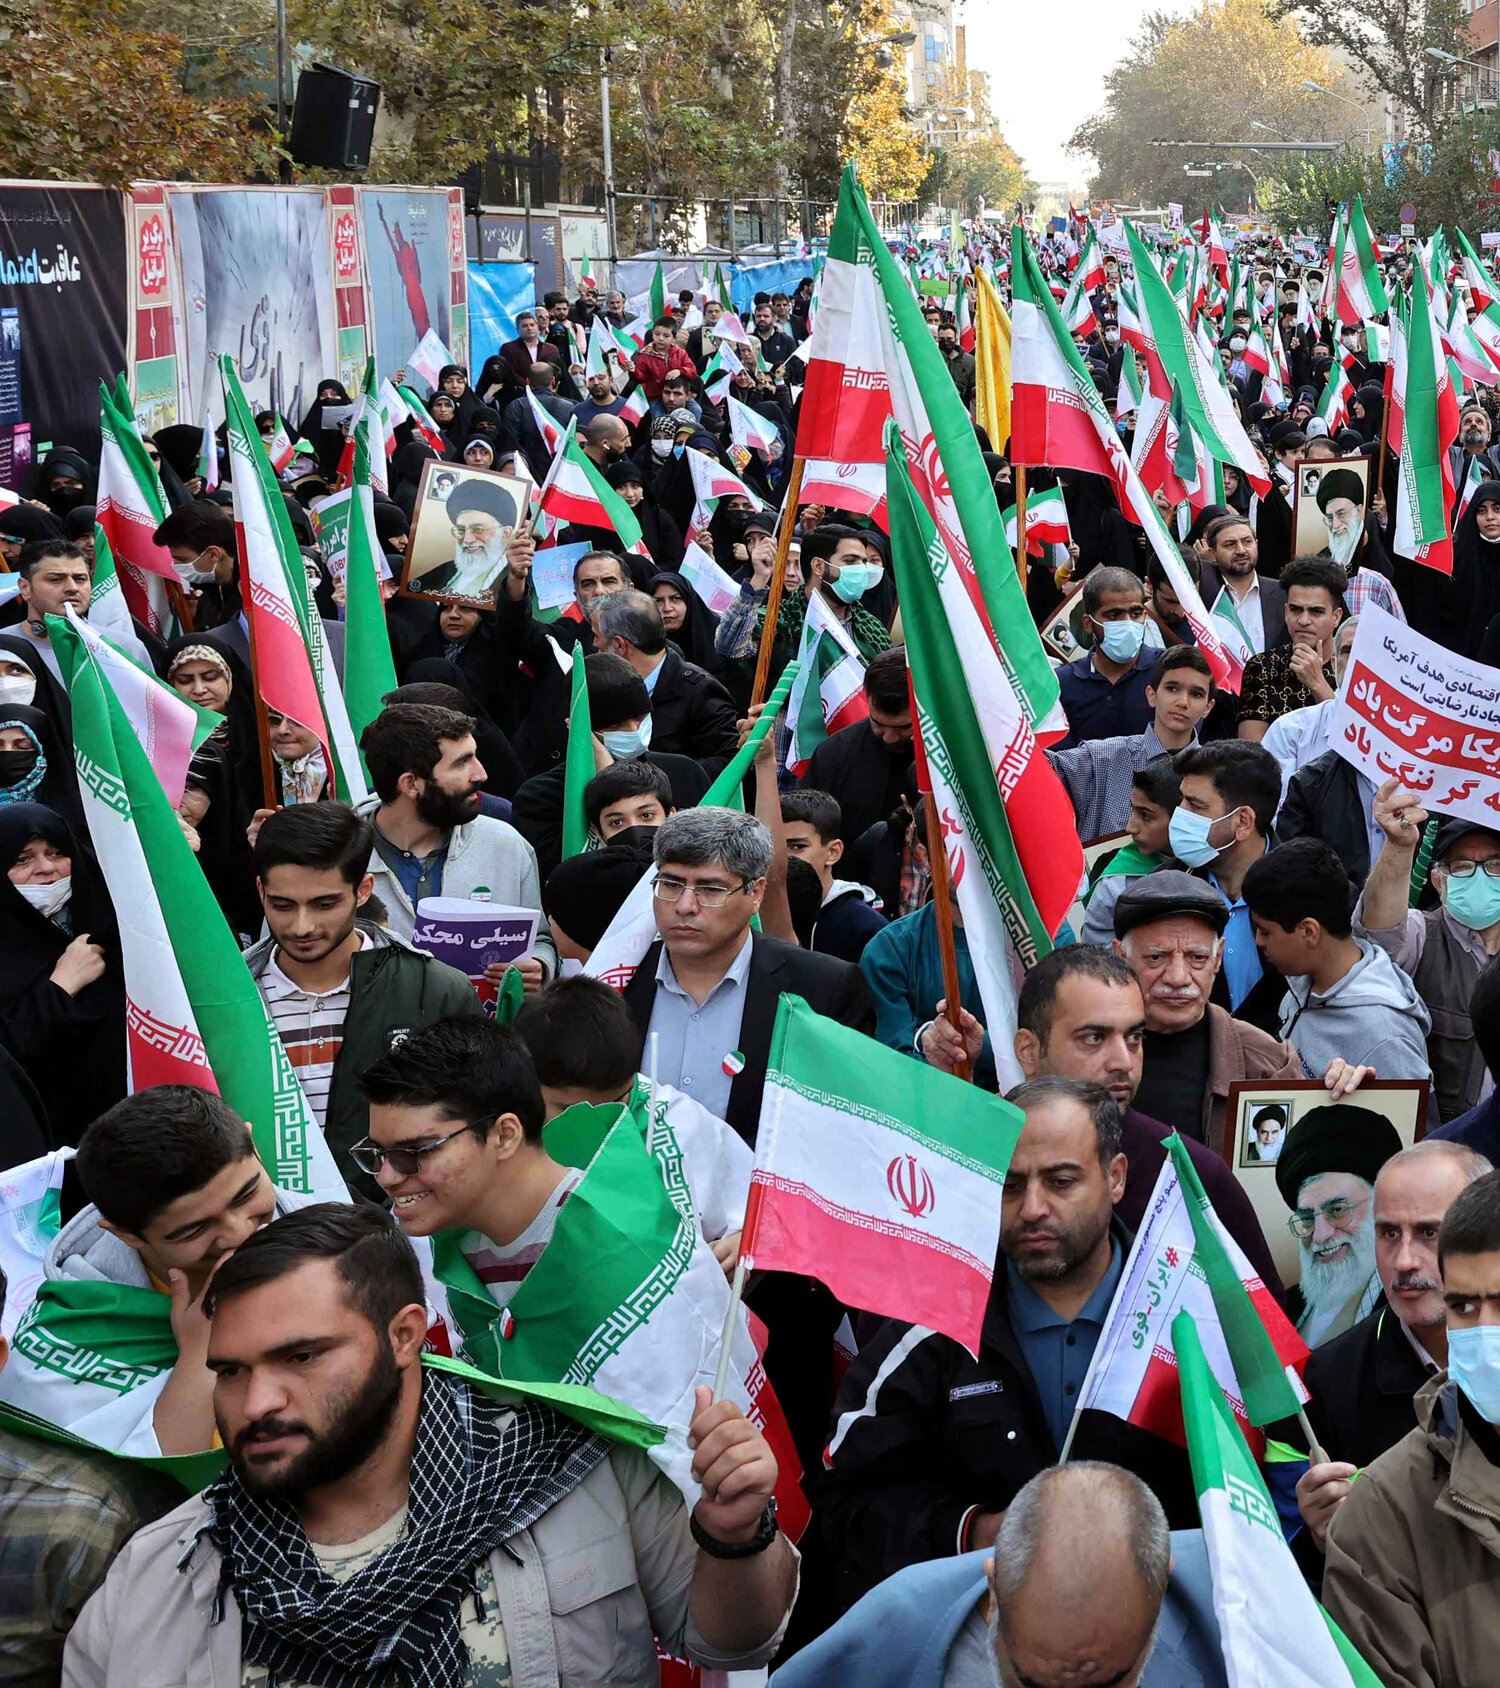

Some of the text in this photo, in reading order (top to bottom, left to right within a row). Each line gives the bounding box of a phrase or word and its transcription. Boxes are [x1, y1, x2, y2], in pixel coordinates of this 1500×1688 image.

[0, 244, 82, 293] عاقبت اعتما
[1382, 636, 1418, 665] آمریکا
[1399, 674, 1424, 695] است
[1416, 660, 1445, 683] هدف
[1353, 678, 1383, 719] باد
[1445, 679, 1500, 704] اقتصادی
[1343, 722, 1372, 763] باد
[1436, 779, 1481, 806] گر
[470, 926, 528, 949] سیلی
